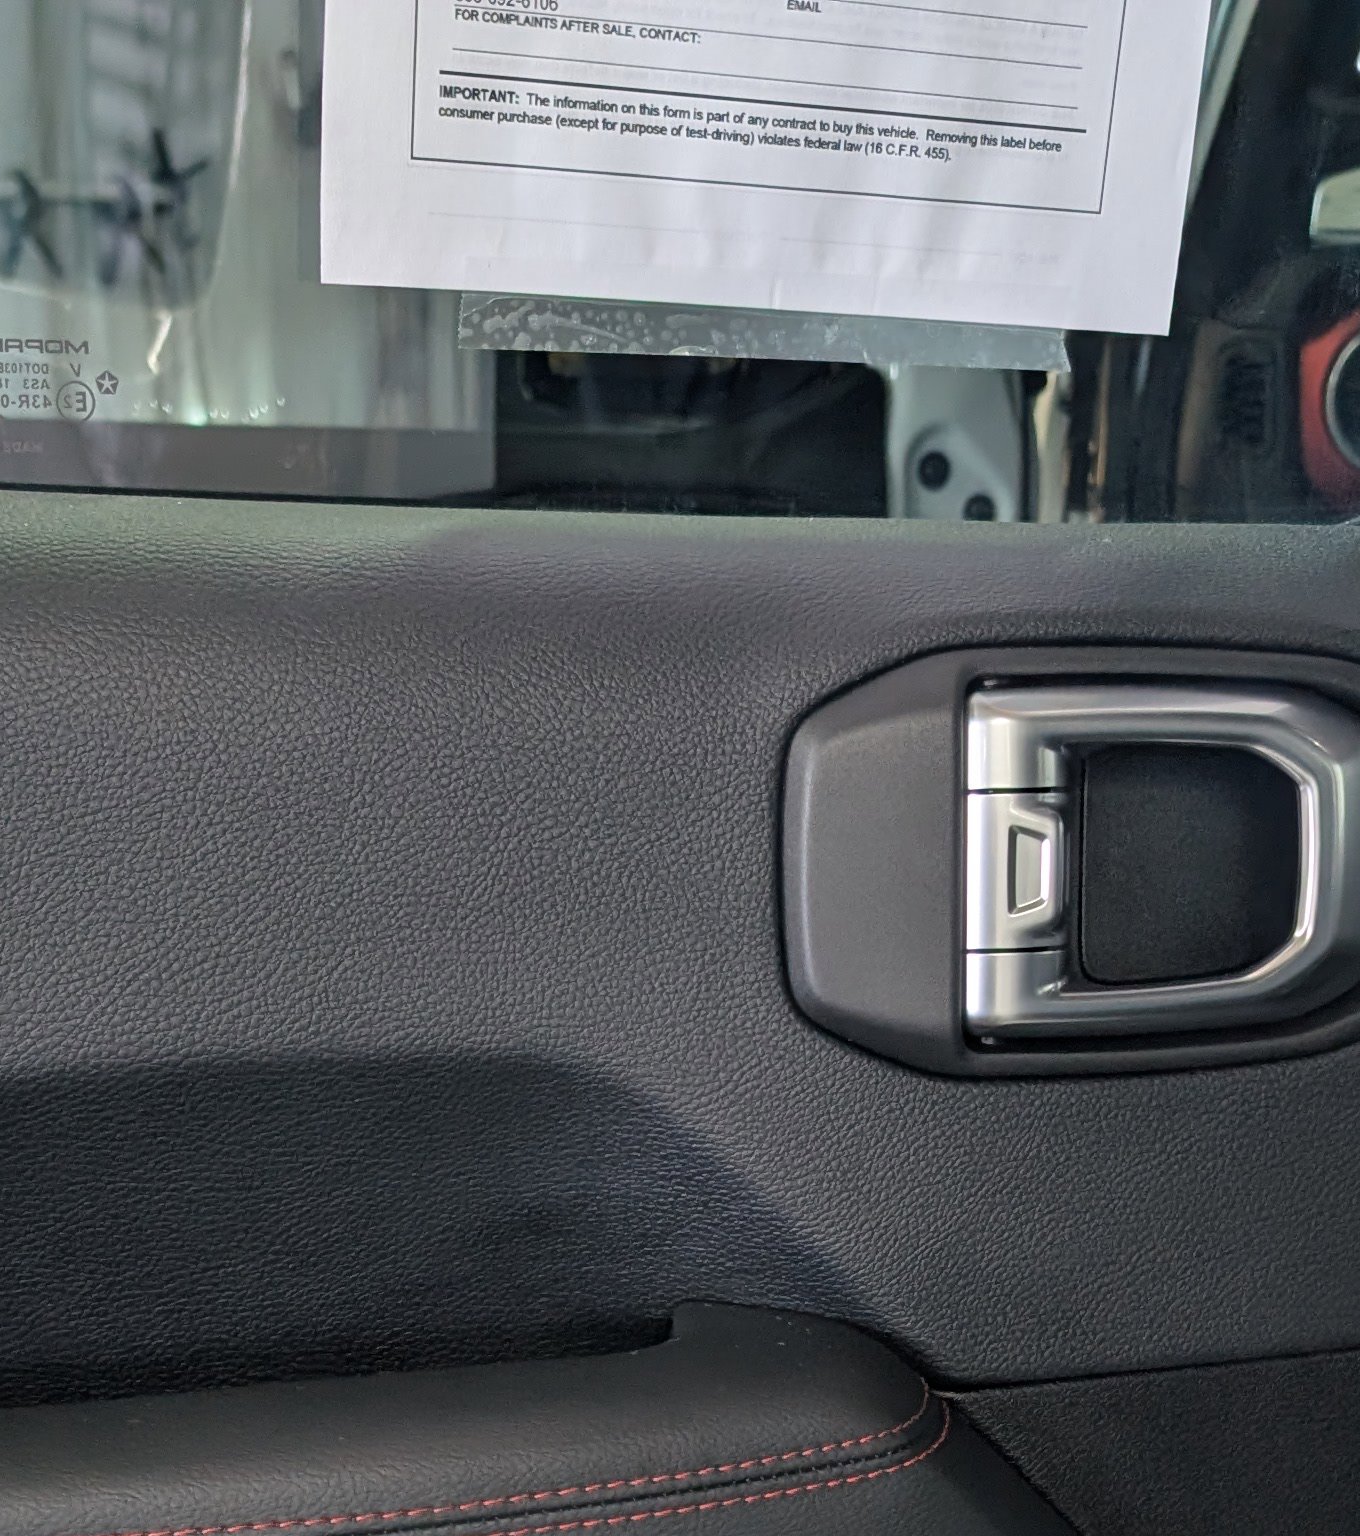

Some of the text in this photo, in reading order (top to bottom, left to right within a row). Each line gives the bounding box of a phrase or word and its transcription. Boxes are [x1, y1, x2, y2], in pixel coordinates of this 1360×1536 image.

[454, 8, 480, 22] FOR
[482, 11, 558, 30] COMPLAINTS
[560, 18, 600, 34] AFTER
[639, 27, 701, 44] CONTACT:
[787, 0, 822, 13] EMAIL
[438, 106, 495, 121] consumer
[497, 110, 552, 127] purchase
[555, 113, 599, 132] (except
[602, 118, 616, 131] for
[620, 122, 668, 137] purpose
[671, 124, 683, 137] of
[686, 126, 755, 146] test-driving)
[758, 133, 801, 148] violates
[803, 136, 841, 151] federal
[843, 139, 862, 153] law
[864, 141, 883, 156] (16
[924, 147, 952, 163] 455).
[439, 85, 1062, 153] IMPORTANT: The information on this form is part of any contract to buy this vehicle. Removing this label before
